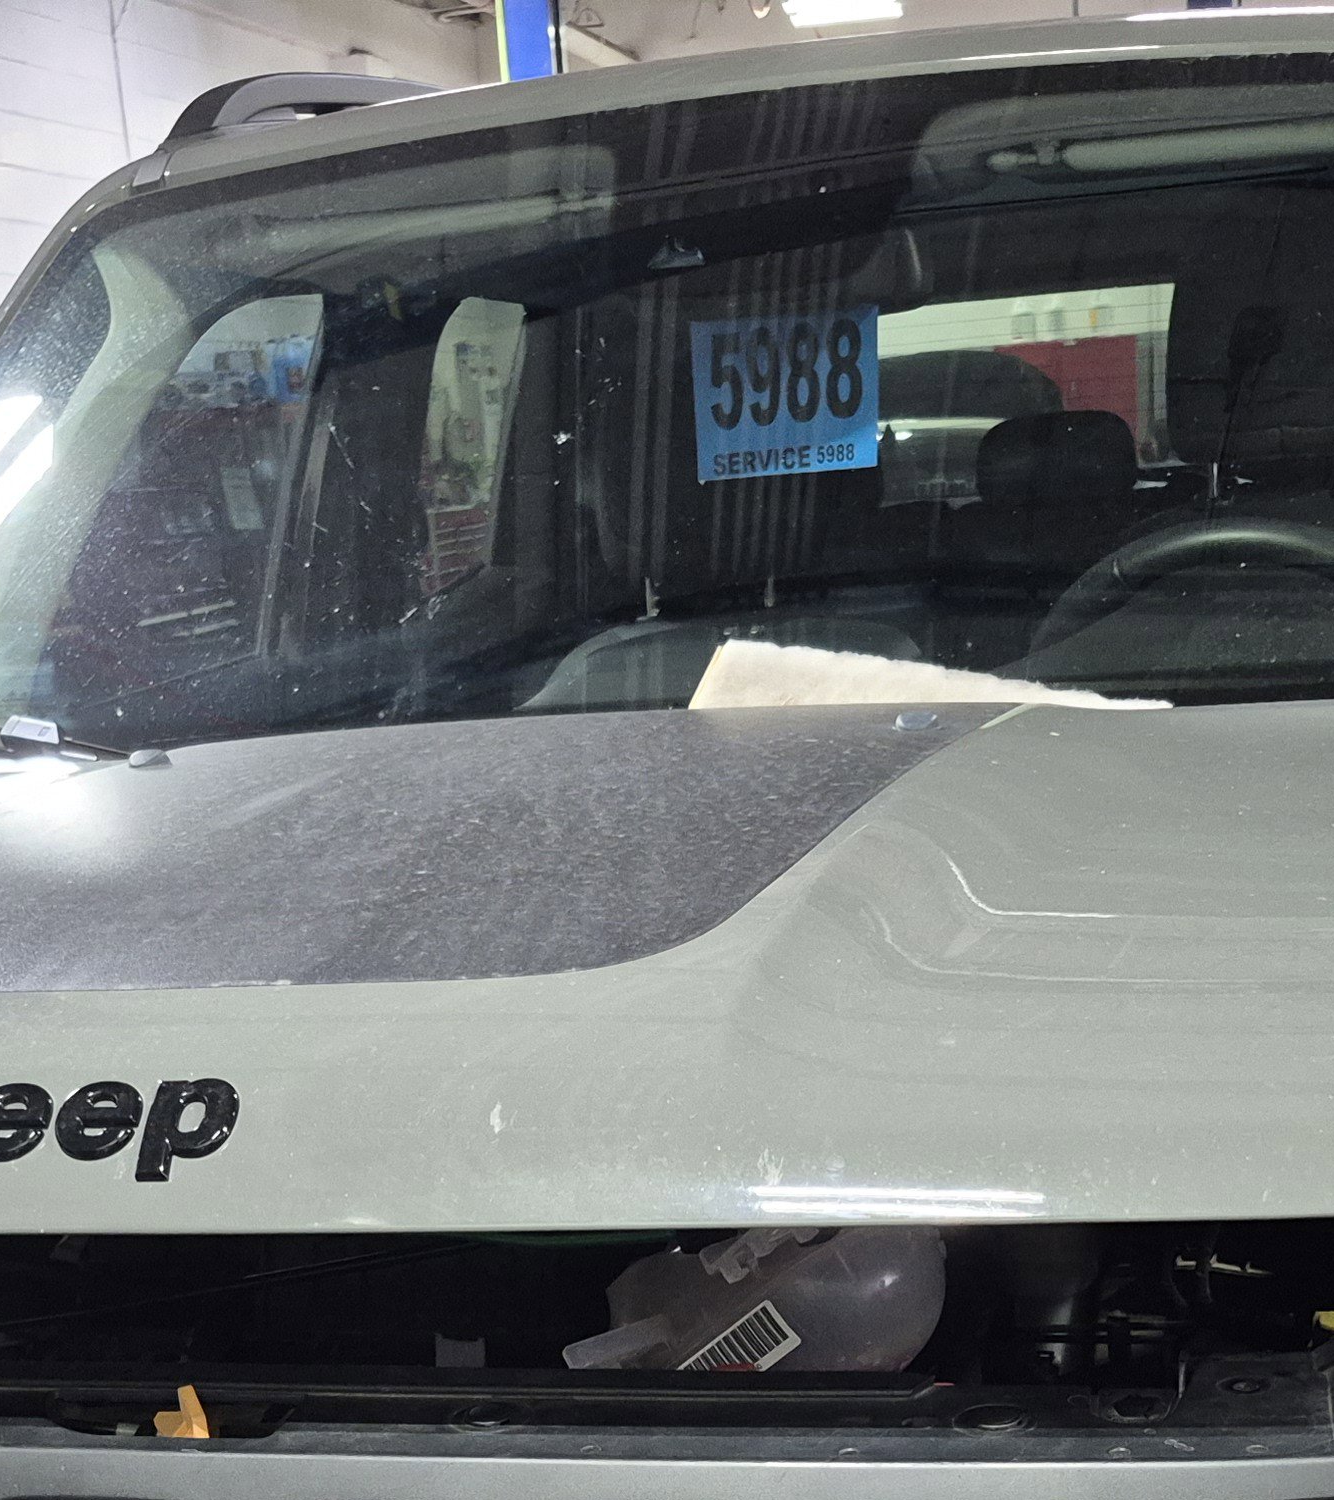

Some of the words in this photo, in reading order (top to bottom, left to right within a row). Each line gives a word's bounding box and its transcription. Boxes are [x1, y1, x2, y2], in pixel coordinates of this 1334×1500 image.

[711, 318, 862, 430] 5988
[713, 446, 811, 475] SERVICE
[817, 443, 855, 464] 5988
